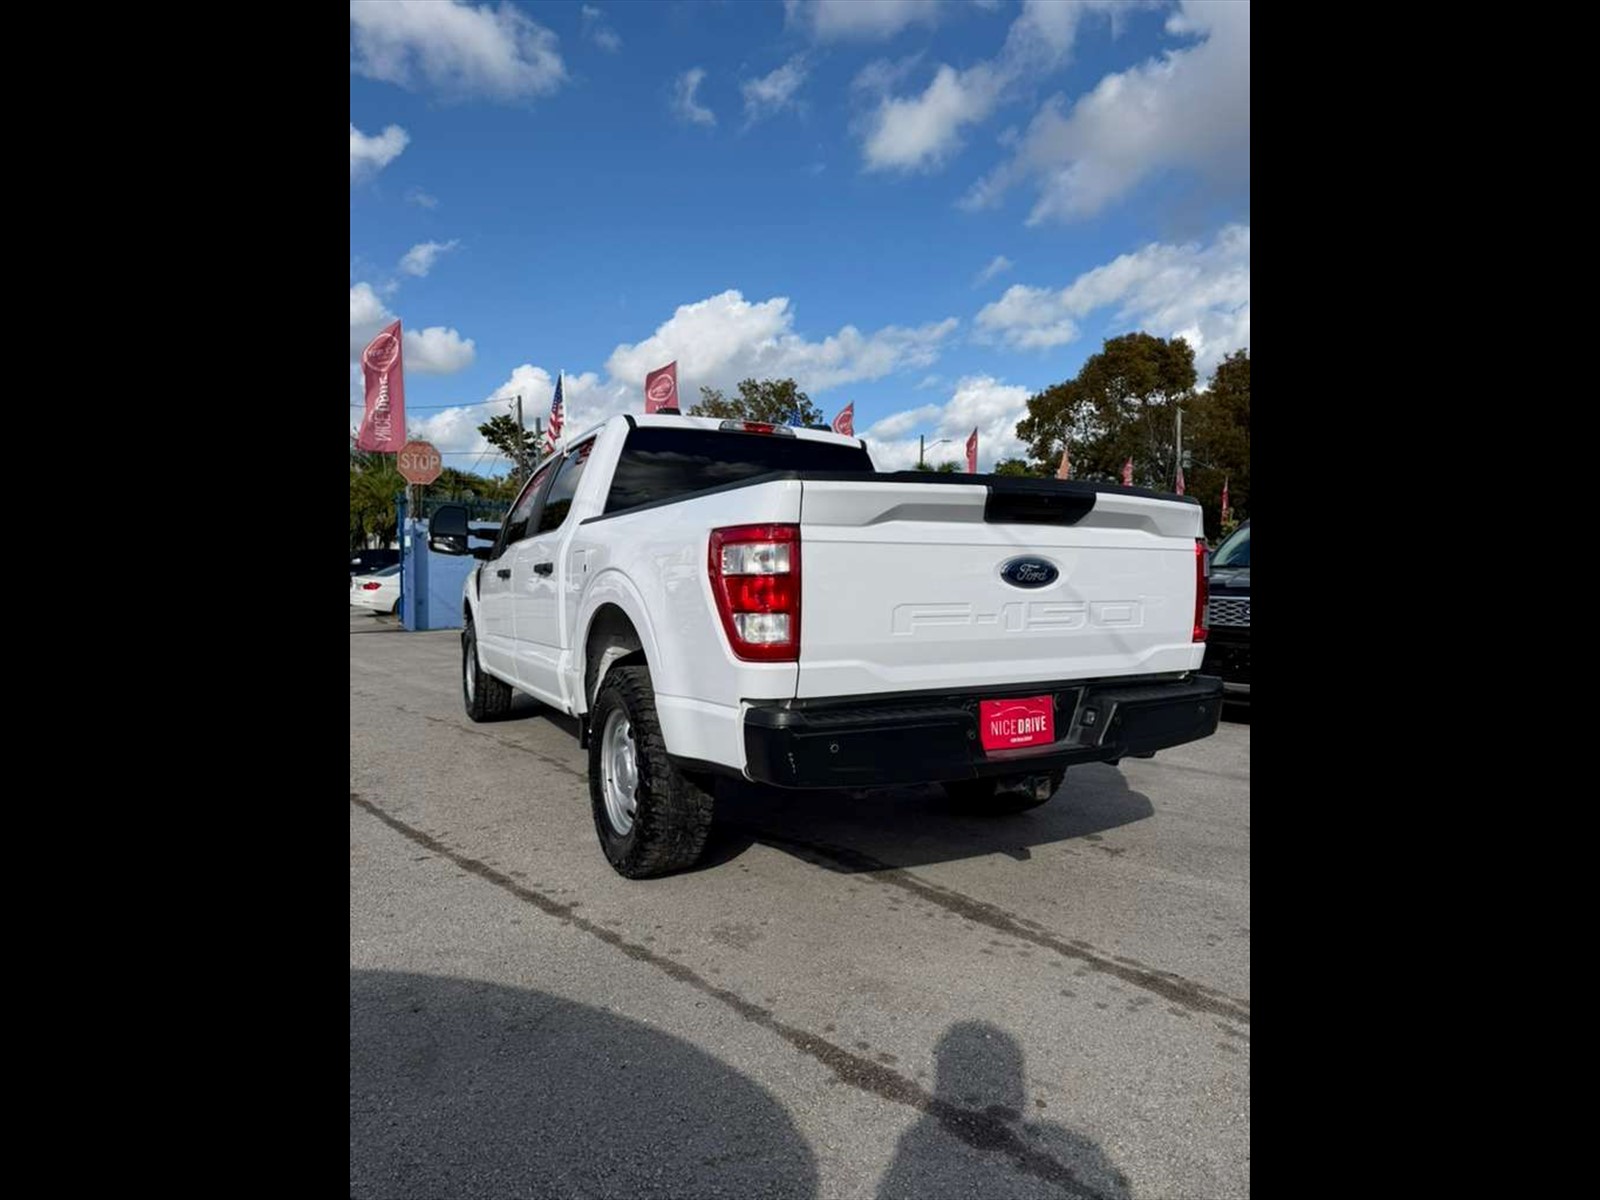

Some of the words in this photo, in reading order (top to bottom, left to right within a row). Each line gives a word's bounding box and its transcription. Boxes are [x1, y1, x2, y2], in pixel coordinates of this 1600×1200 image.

[401, 454, 440, 470] STOP
[1016, 563, 1048, 581] Ford
[892, 600, 1145, 636] F-150
